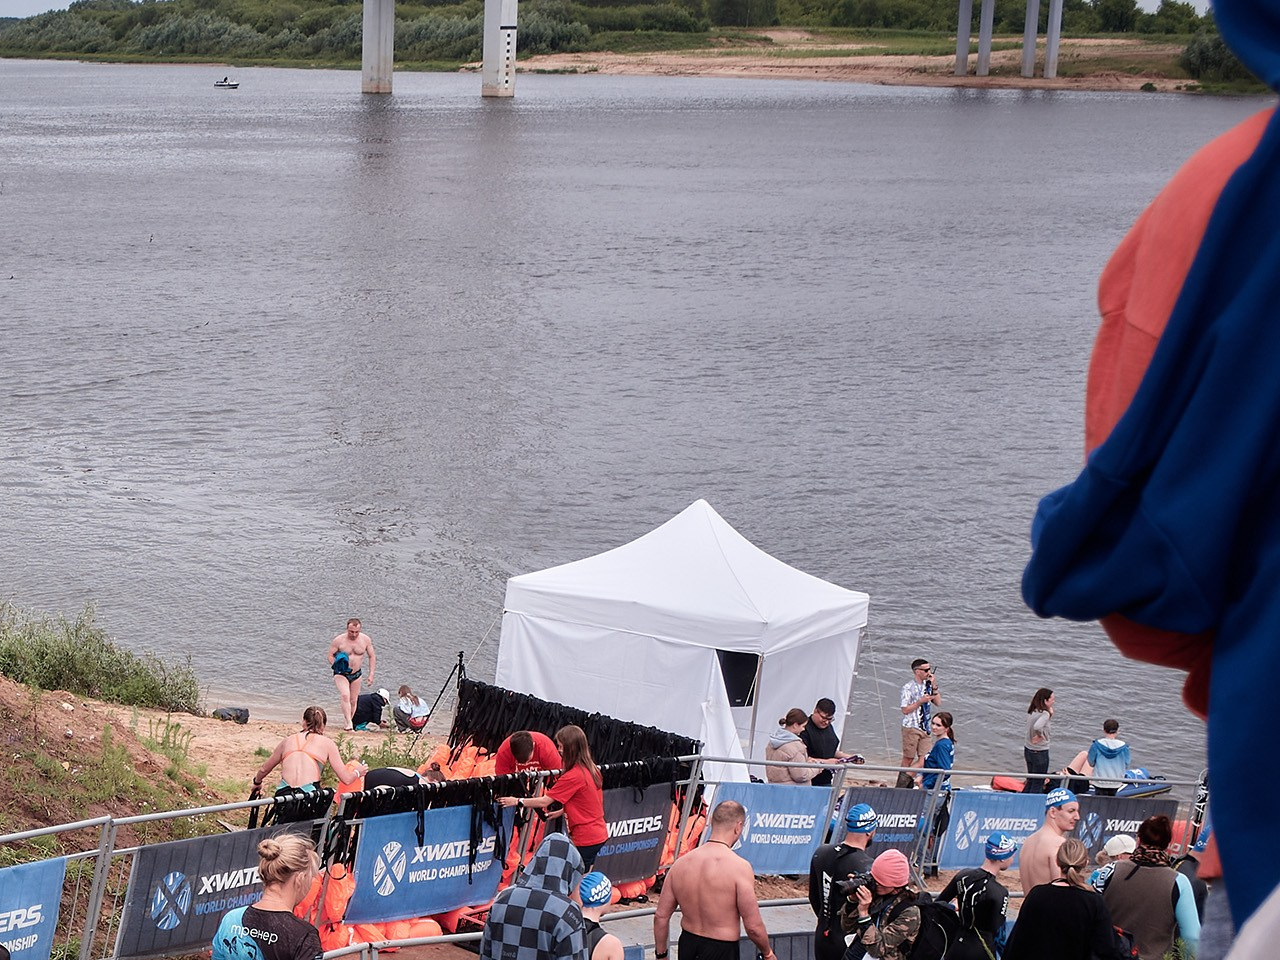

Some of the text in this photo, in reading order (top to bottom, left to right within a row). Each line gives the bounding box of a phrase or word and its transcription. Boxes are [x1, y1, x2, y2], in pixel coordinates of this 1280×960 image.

[750, 833, 770, 844] WORLD
[409, 860, 492, 883] WORLD CHAMPINSHIP
[195, 898, 226, 916] WORLD
